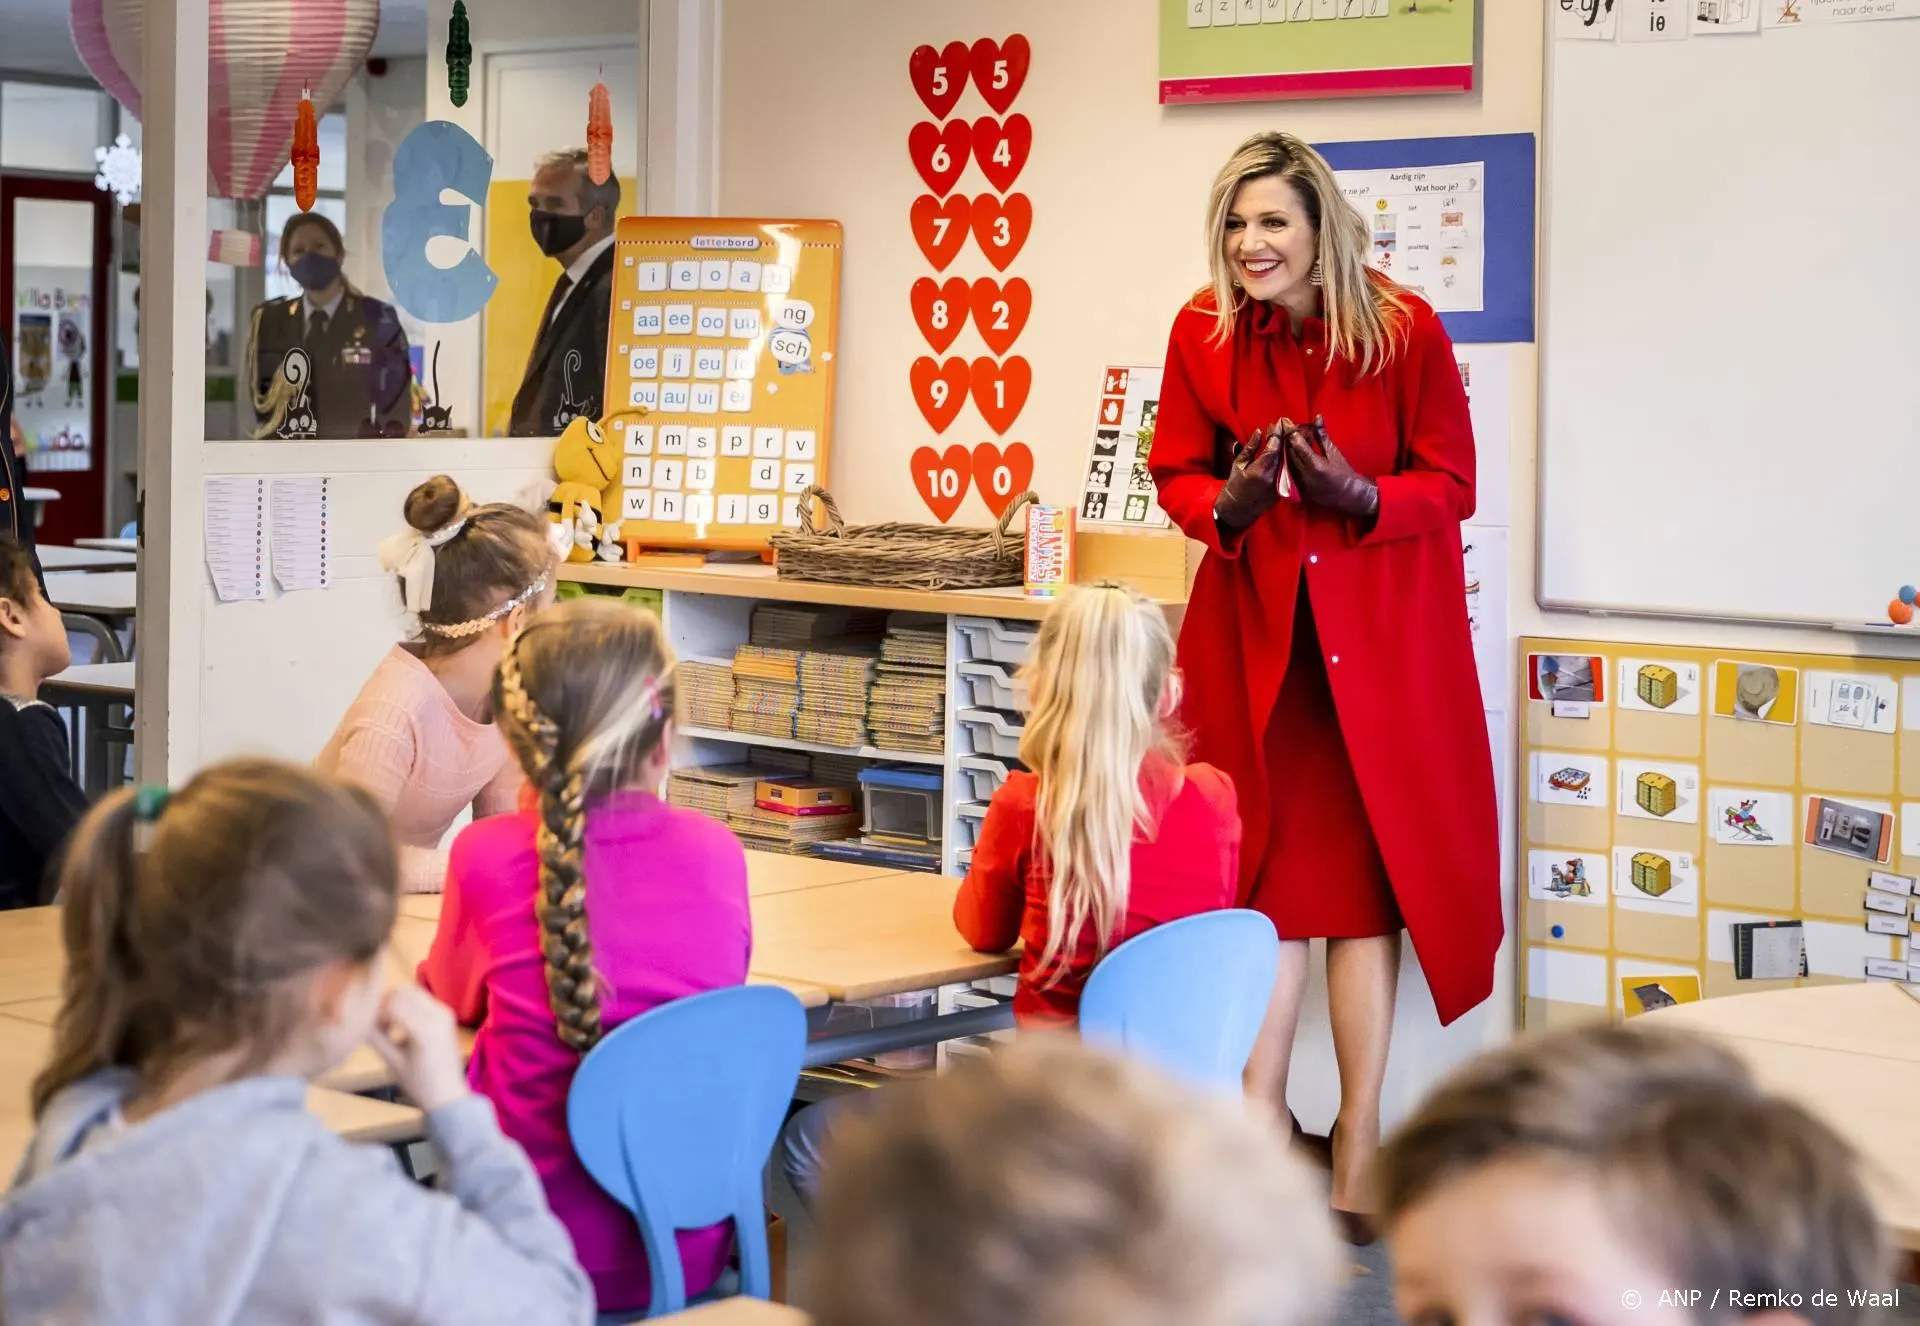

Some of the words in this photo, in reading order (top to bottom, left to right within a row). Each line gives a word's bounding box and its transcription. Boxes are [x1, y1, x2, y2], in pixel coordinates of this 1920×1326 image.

[1832, 7, 1857, 16] naar
[1859, 5, 1874, 14] de
[932, 67, 949, 96] 5
[992, 60, 1009, 89] 5
[931, 144, 951, 173] 6
[992, 139, 1012, 167] 4
[1390, 173, 1412, 182] Aardig
[1414, 173, 1426, 181] zijn
[1448, 183, 1459, 192] je?
[932, 218, 951, 246] 7
[992, 216, 1011, 247] 3
[695, 238, 755, 247] letterbord
[681, 270, 692, 282] e
[710, 270, 720, 281] o
[740, 271, 751, 282] a
[638, 315, 659, 328] aa
[669, 314, 690, 326] ee
[701, 317, 724, 329] oo
[734, 318, 757, 330] uu
[784, 307, 806, 323] ng
[931, 299, 949, 330] 8
[991, 301, 1010, 330] 2
[775, 339, 808, 358] sch
[634, 357, 656, 370] oe
[673, 354, 681, 373] ij
[699, 358, 721, 370] eu
[634, 390, 655, 403] ou
[664, 392, 687, 405] au
[697, 390, 713, 405] ui
[930, 379, 949, 409] 9
[994, 380, 1005, 409] 1
[634, 431, 644, 446] k
[665, 434, 681, 446] m
[697, 437, 707, 448] s
[731, 435, 742, 450] p
[766, 437, 772, 449] r
[796, 440, 806, 451] v
[632, 466, 642, 478] n
[666, 467, 672, 481] t
[695, 465, 707, 480] b
[760, 465, 771, 480] d
[796, 473, 805, 485] z
[927, 468, 959, 498] 10
[993, 466, 1012, 496] 0
[630, 498, 645, 509] w
[664, 497, 673, 513] h
[729, 500, 735, 519] j
[758, 504, 769, 519] g
